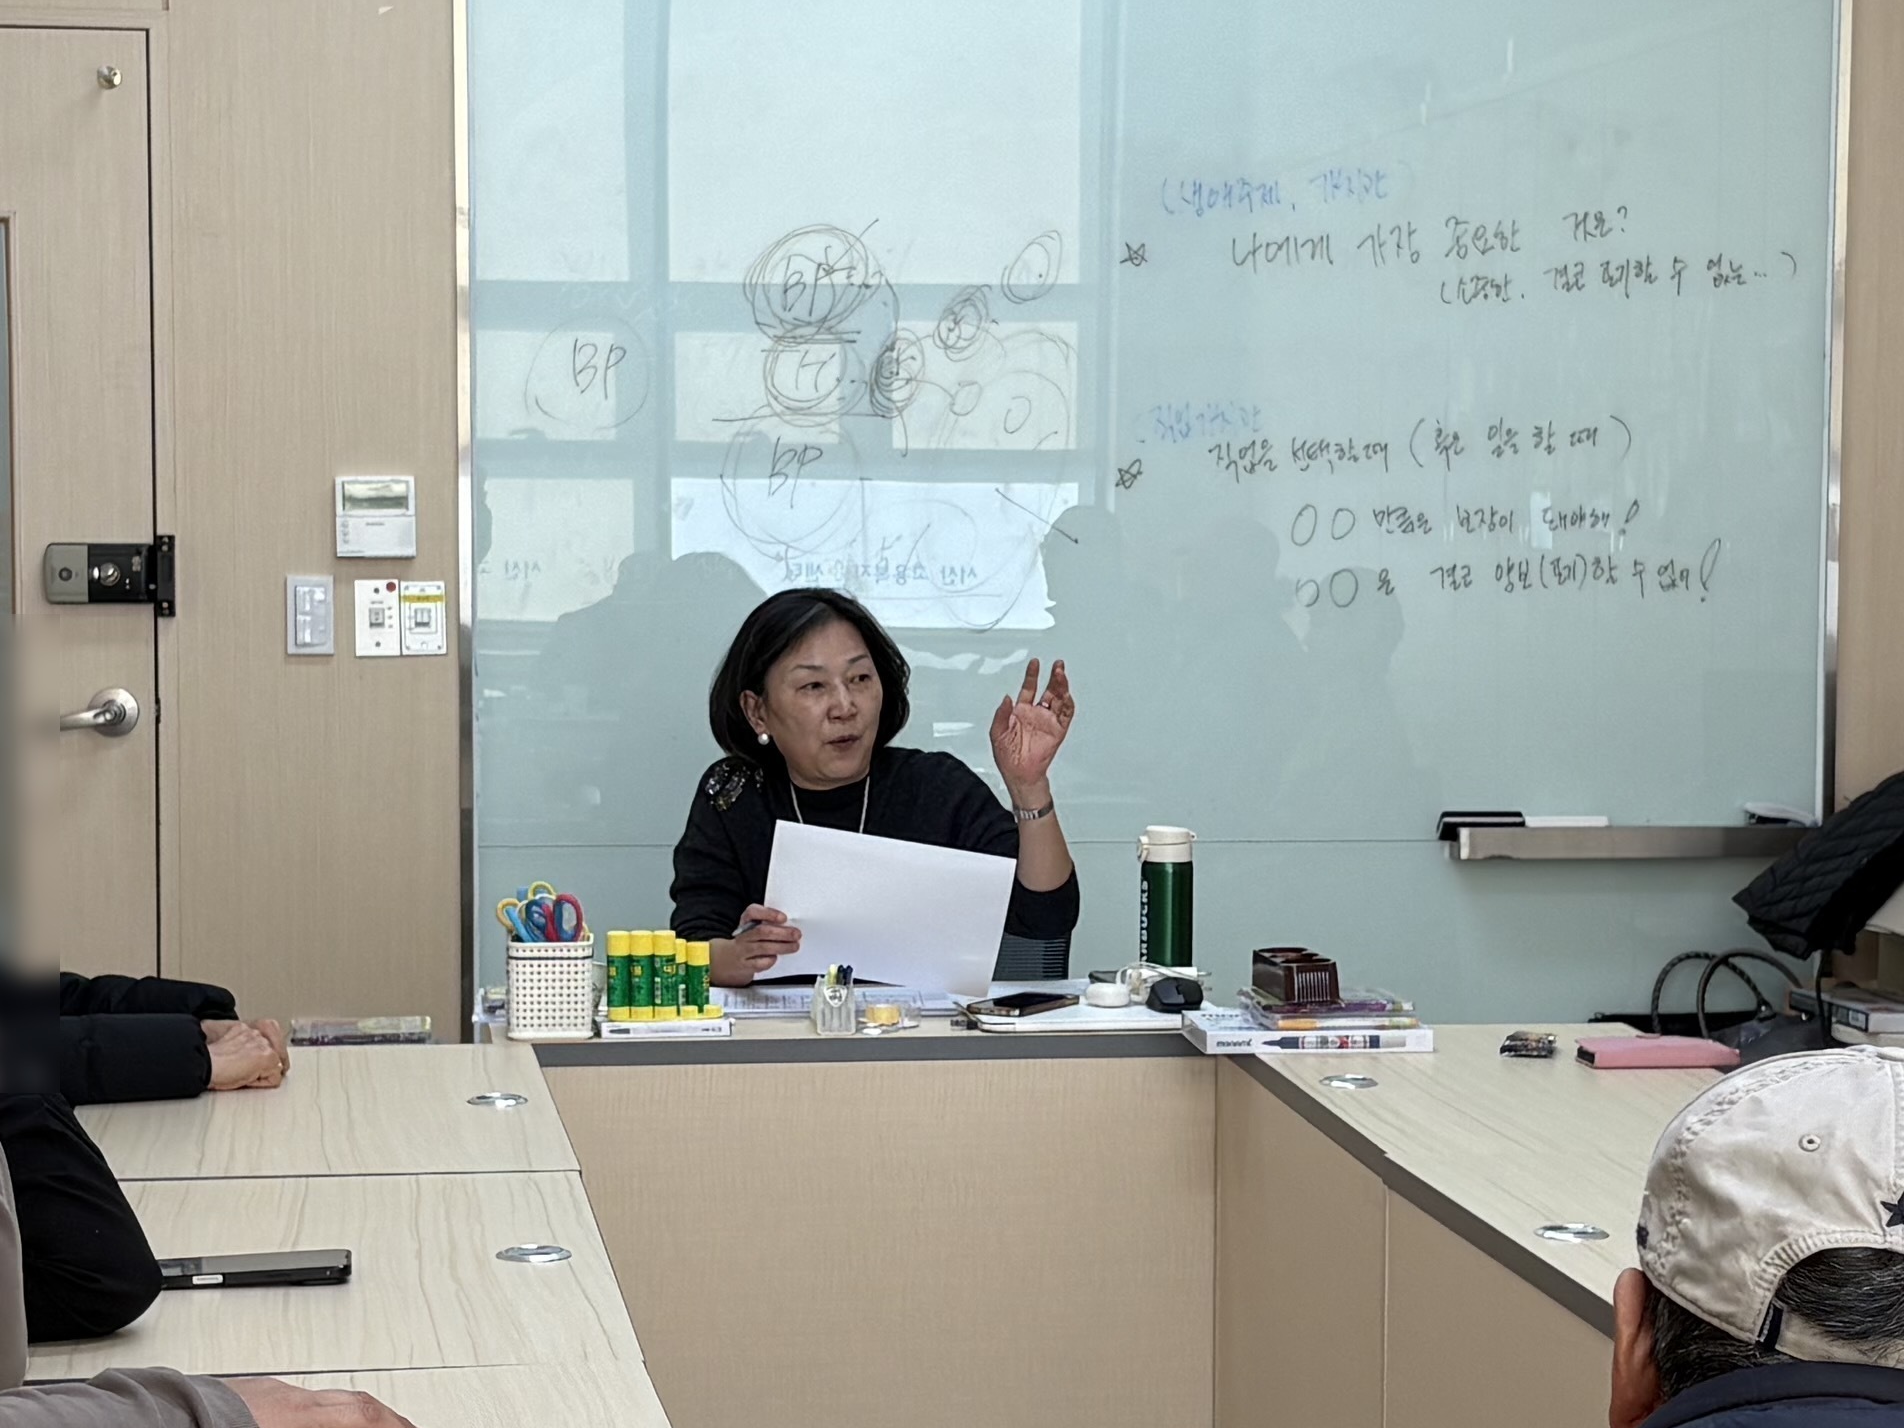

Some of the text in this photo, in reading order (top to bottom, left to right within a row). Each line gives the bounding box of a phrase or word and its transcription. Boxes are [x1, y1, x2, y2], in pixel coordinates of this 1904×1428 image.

[1232, 232, 1334, 274] 나에게
[1357, 221, 1422, 268] 가장
[1444, 215, 1522, 260] 중요한
[1600, 254, 1659, 300] 포기할
[1671, 256, 1689, 298] 수
[1207, 438, 1279, 484] 직업을
[1487, 416, 1519, 458] 일을
[1531, 419, 1557, 456] 할
[1456, 504, 1514, 534] 보장이
[1429, 563, 1473, 592] 결코
[1631, 558, 1646, 599] 수
